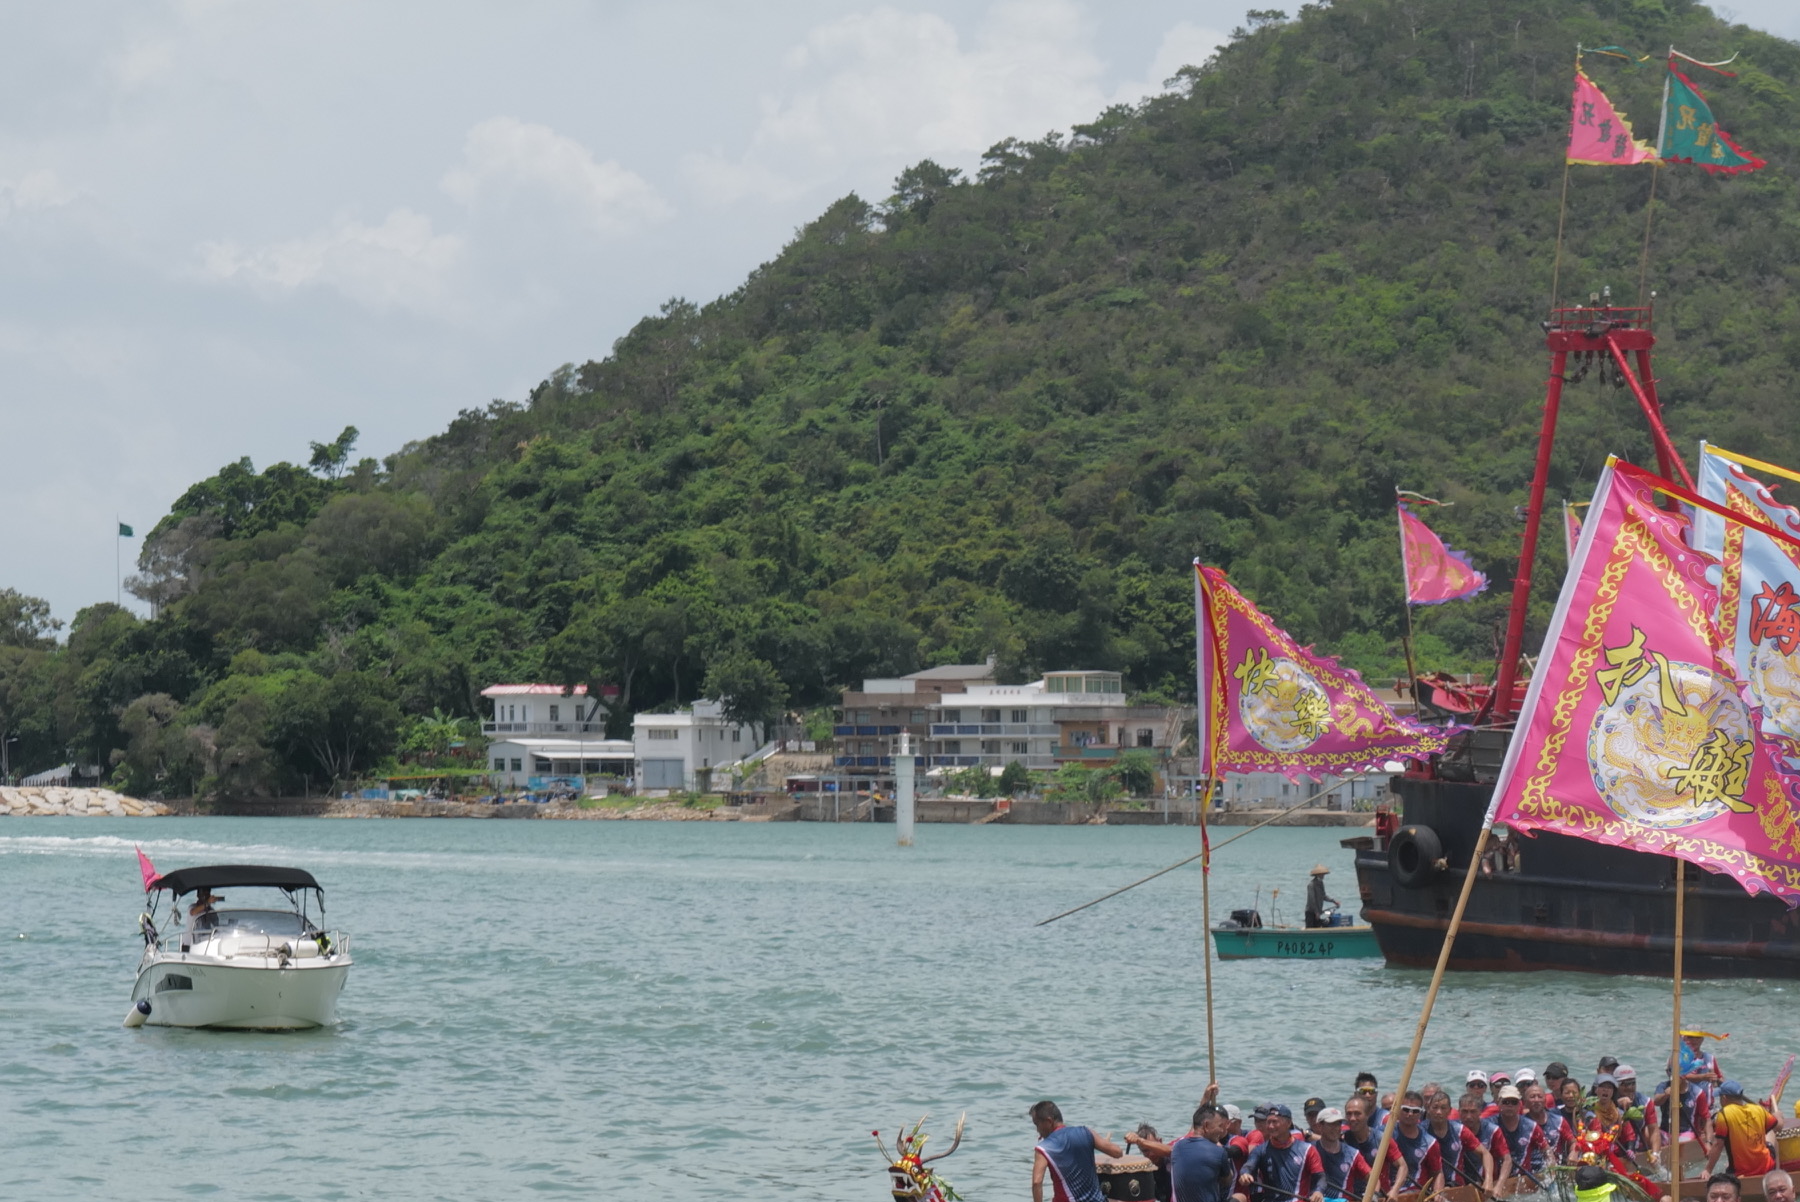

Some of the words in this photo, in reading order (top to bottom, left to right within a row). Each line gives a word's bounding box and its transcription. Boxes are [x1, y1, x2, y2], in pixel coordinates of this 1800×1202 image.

[1233, 647, 1335, 741] 快樂
[1595, 624, 1754, 814] 扒艇
[1277, 942, 1334, 956] P40824P
